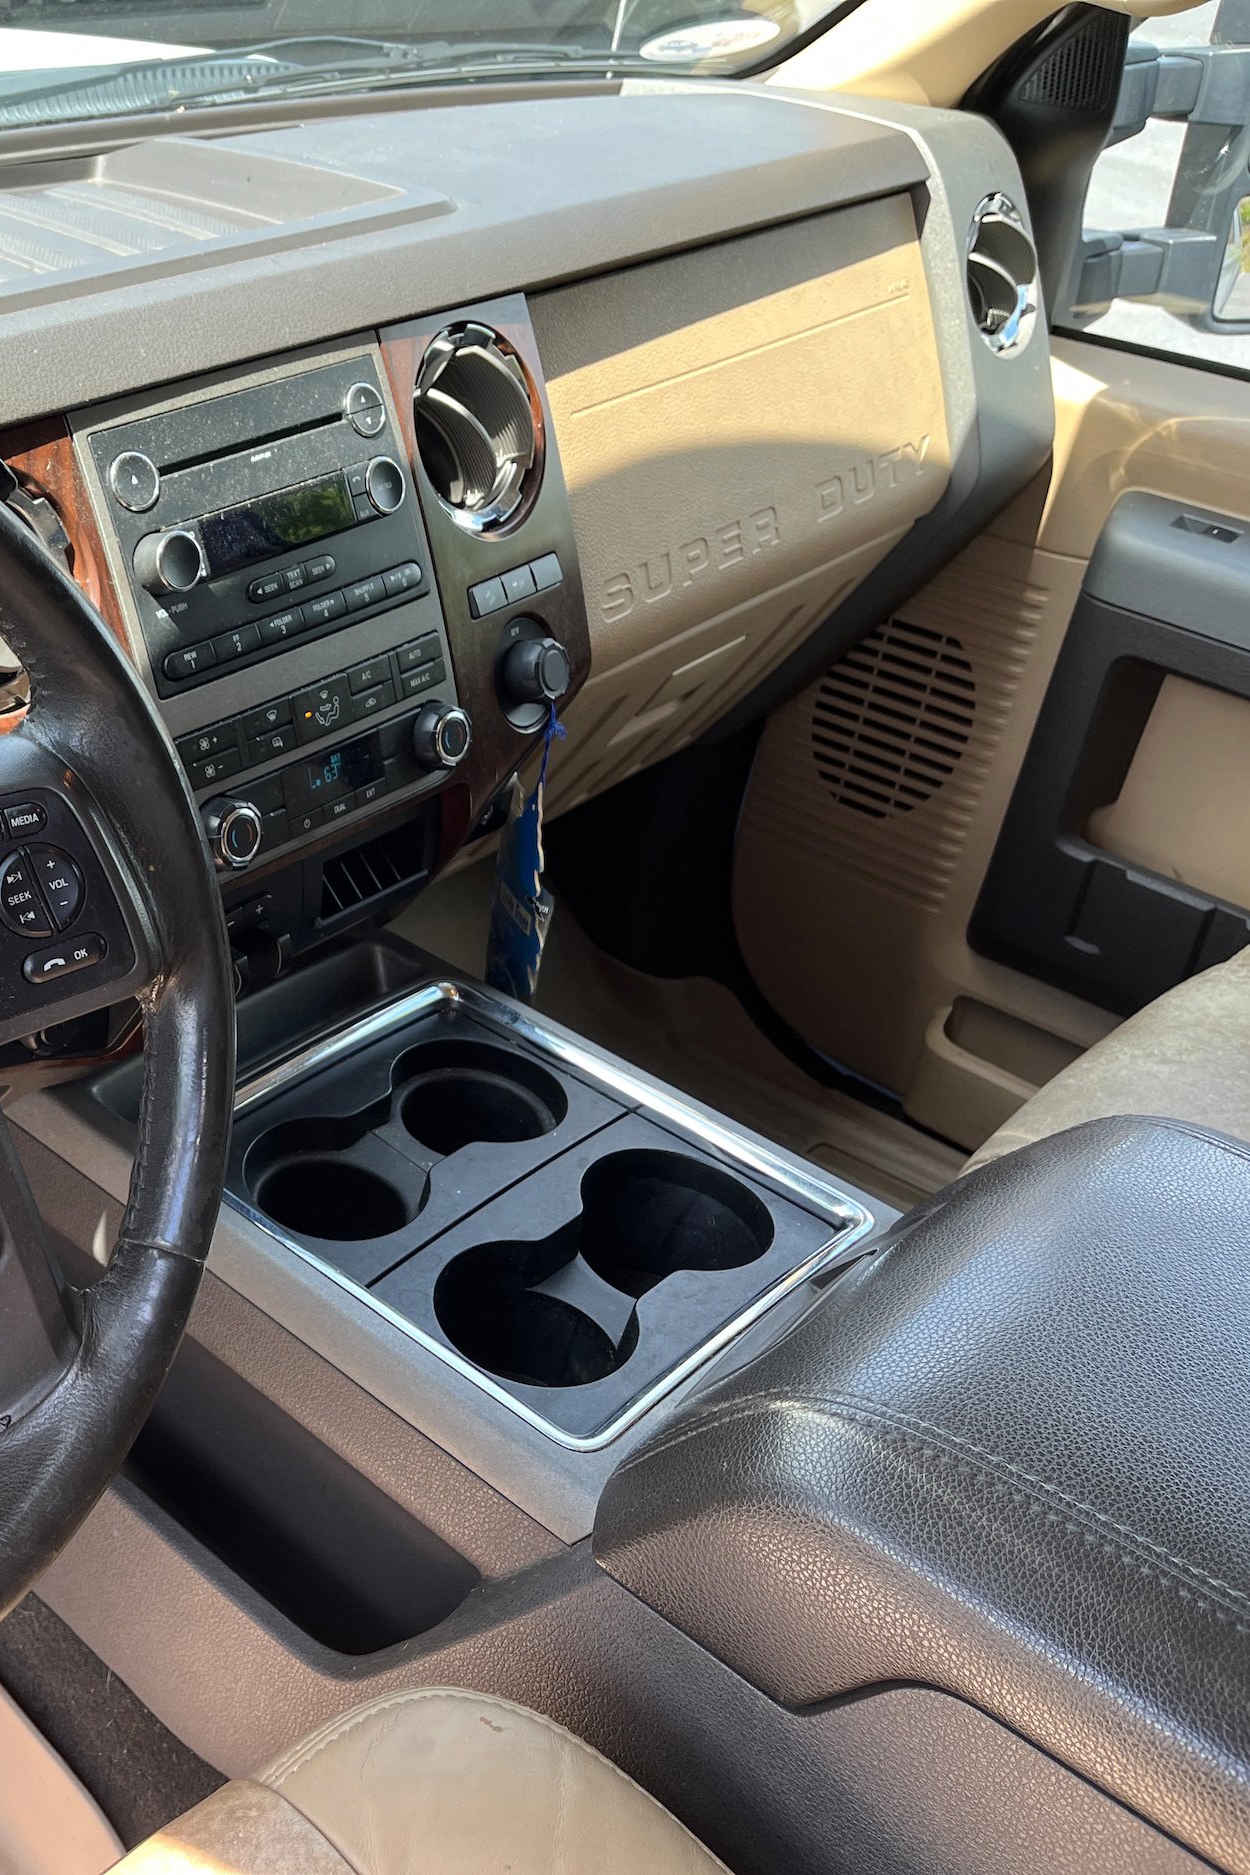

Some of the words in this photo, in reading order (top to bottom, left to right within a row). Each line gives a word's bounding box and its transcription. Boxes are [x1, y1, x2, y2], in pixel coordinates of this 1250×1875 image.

[599, 505, 780, 623] SUPER
[814, 433, 931, 524] DUTY
[287, 568, 300, 580] TEXT
[354, 583, 374, 596] SHUFFLE
[312, 601, 330, 612] FOLDER
[323, 609, 329, 617] 4
[274, 615, 292, 627] FOLDER
[280, 625, 287, 635] 3
[233, 634, 240, 642] FF
[236, 642, 242, 652] 2
[183, 650, 197, 661] REW
[409, 648, 422, 660] AUTO
[191, 660, 196, 669] 1
[361, 671, 371, 681] A/C
[410, 678, 421, 687] MAX
[421, 672, 431, 682] A/C
[366, 787, 376, 798] EXT
[333, 803, 347, 814] DUAL
[11, 813, 40, 828] MEDIA
[49, 878, 69, 891] VOL
[8, 890, 32, 907] SEEK
[73, 948, 88, 961] OK
